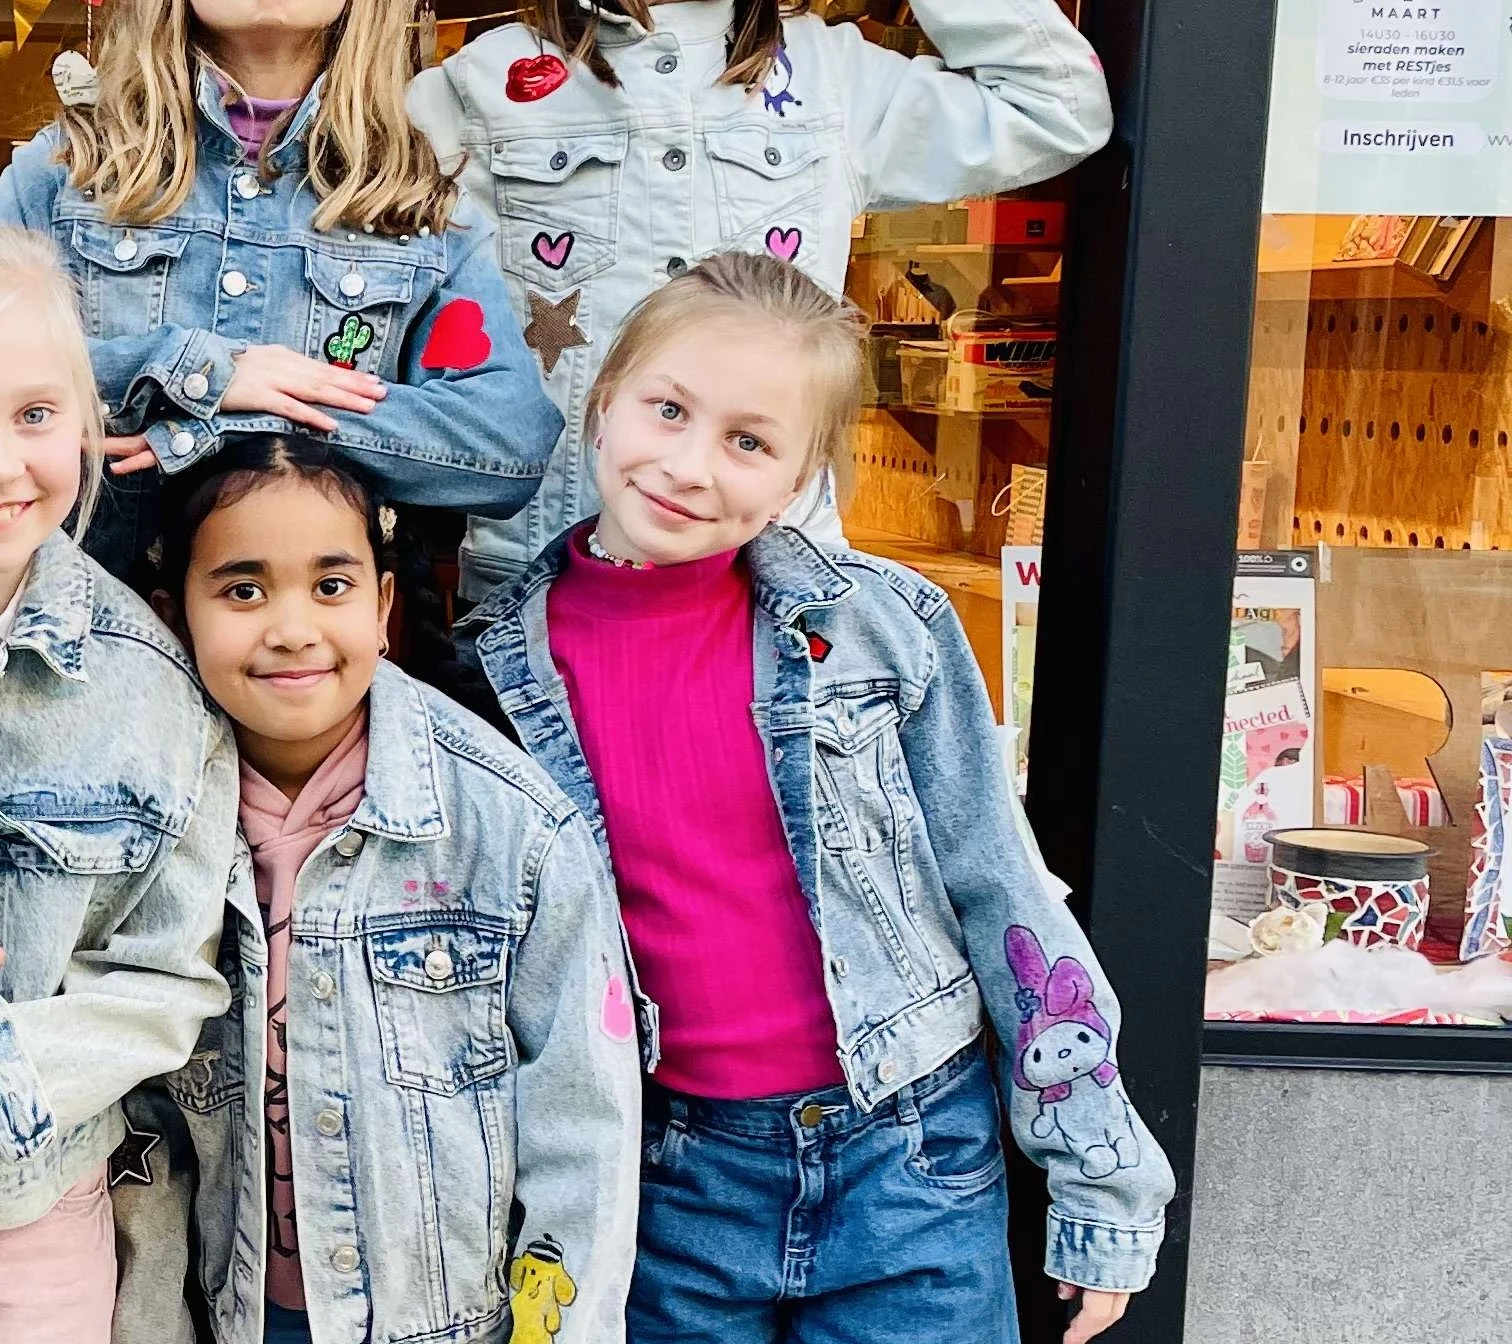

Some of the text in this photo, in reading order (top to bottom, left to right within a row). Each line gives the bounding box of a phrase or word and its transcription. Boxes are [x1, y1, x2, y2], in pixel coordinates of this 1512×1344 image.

[1372, 8, 1441, 20] MAART
[1347, 42, 1465, 56] sieraden maken
[1363, 60, 1451, 75] met RESTjes
[1343, 129, 1454, 152] Inschrijven
[1224, 706, 1294, 733] nected
